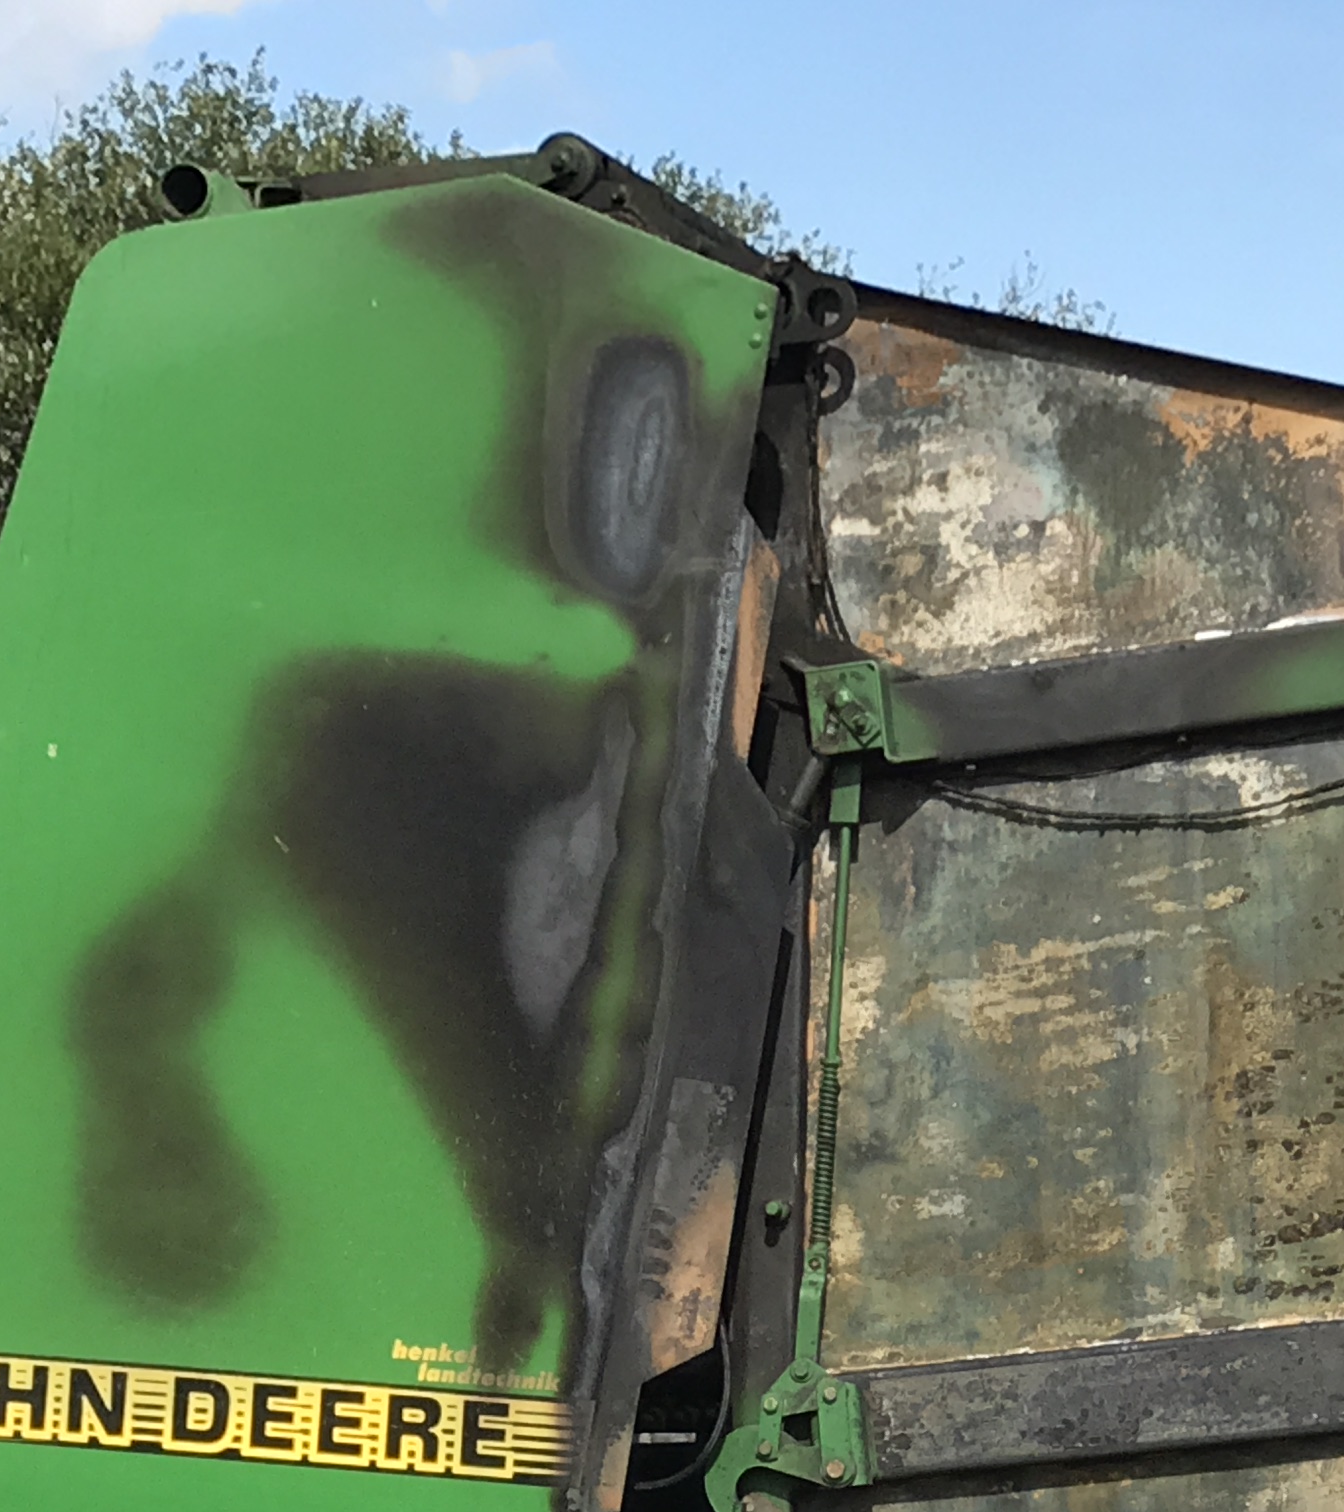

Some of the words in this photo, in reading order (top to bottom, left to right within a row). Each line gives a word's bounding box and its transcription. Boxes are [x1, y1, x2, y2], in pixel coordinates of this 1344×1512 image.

[392, 1338, 477, 1363] henkel
[417, 1362, 560, 1391] landtechnik
[171, 1376, 512, 1470] DEERE
